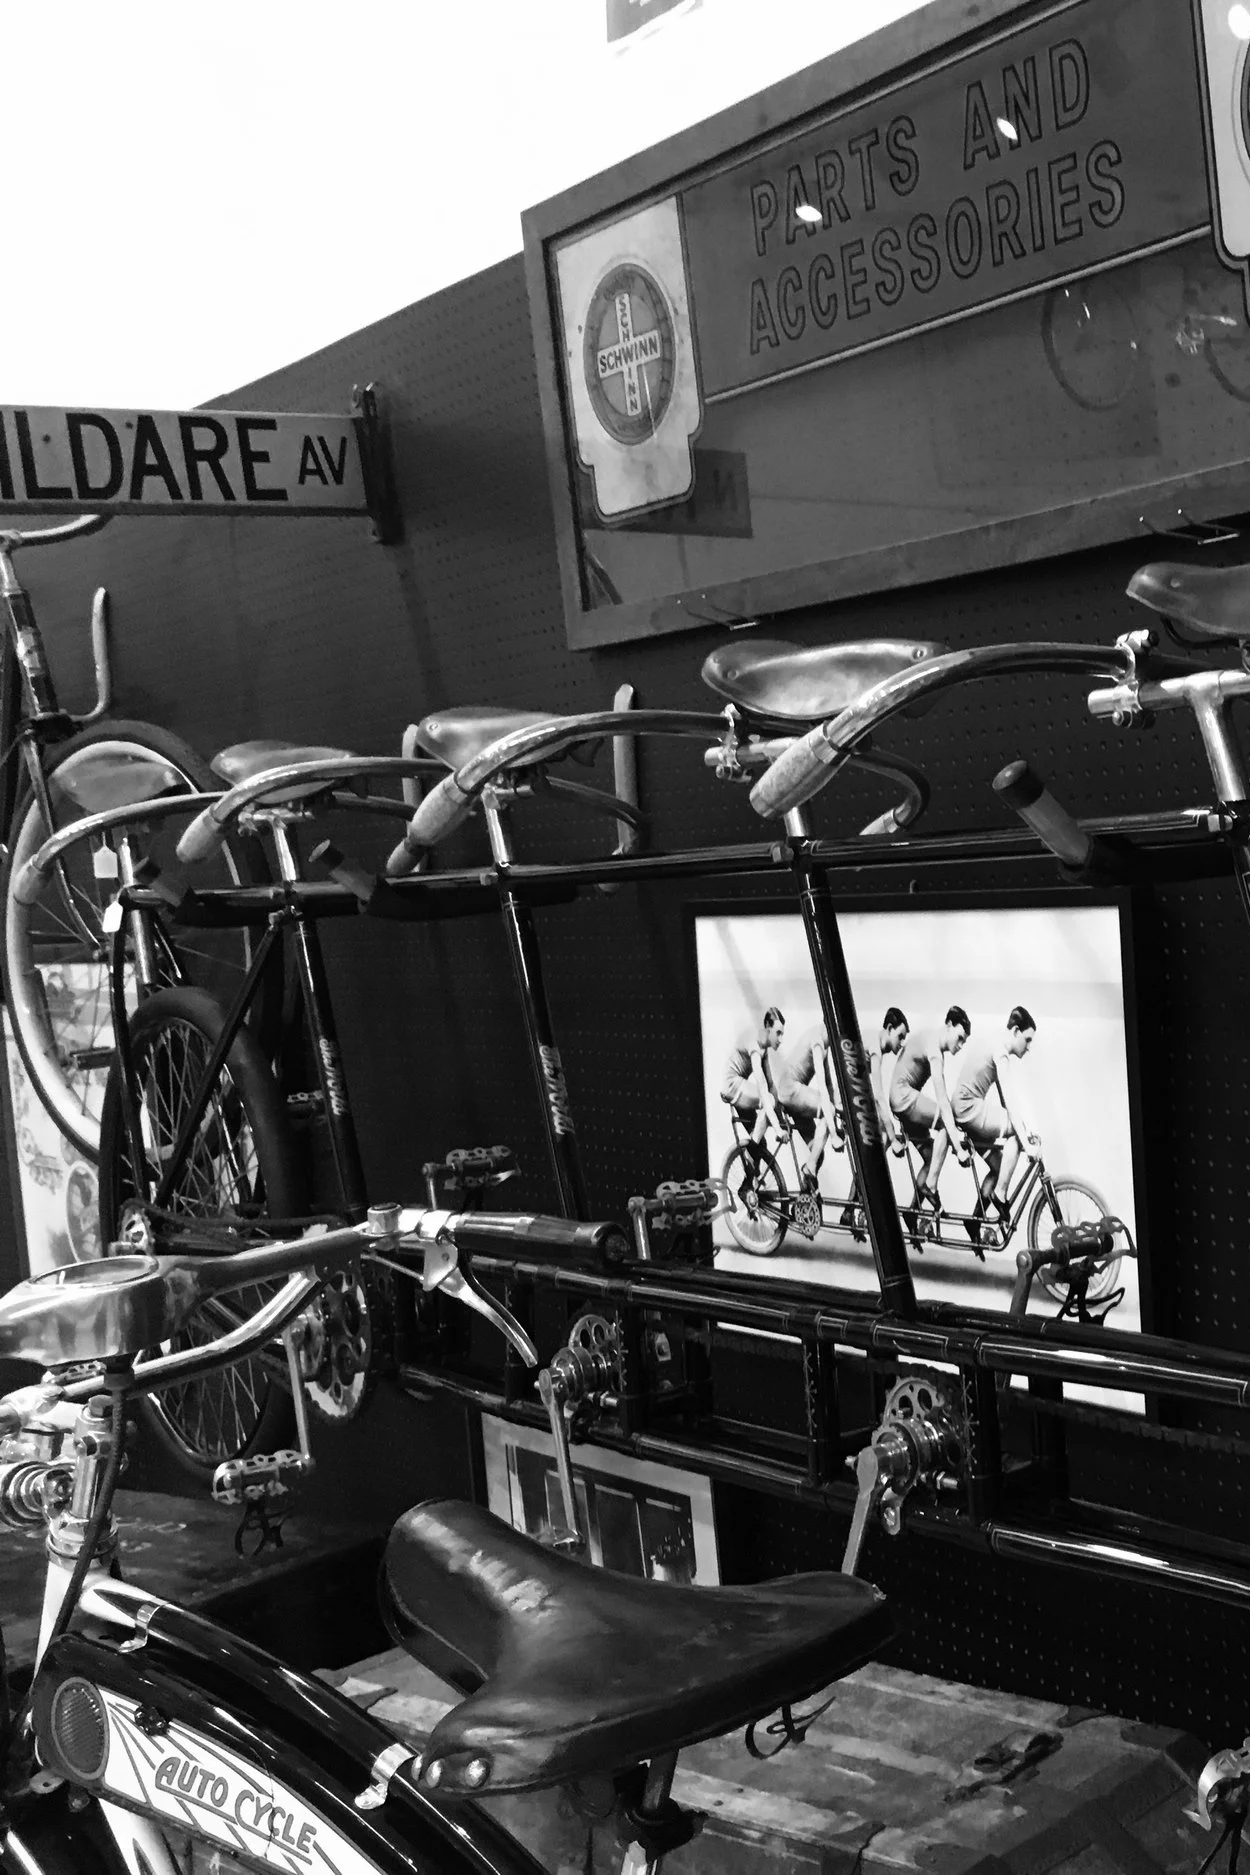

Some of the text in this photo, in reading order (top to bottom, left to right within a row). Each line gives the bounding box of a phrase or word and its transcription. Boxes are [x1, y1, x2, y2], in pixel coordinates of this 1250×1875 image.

[749, 38, 1091, 257] PARTS AND
[749, 139, 1126, 355] ACCESSORIES
[599, 334, 659, 375] SCHWINN
[298, 435, 348, 486] AV
[155, 1756, 318, 1861] AUTO CYCLE
